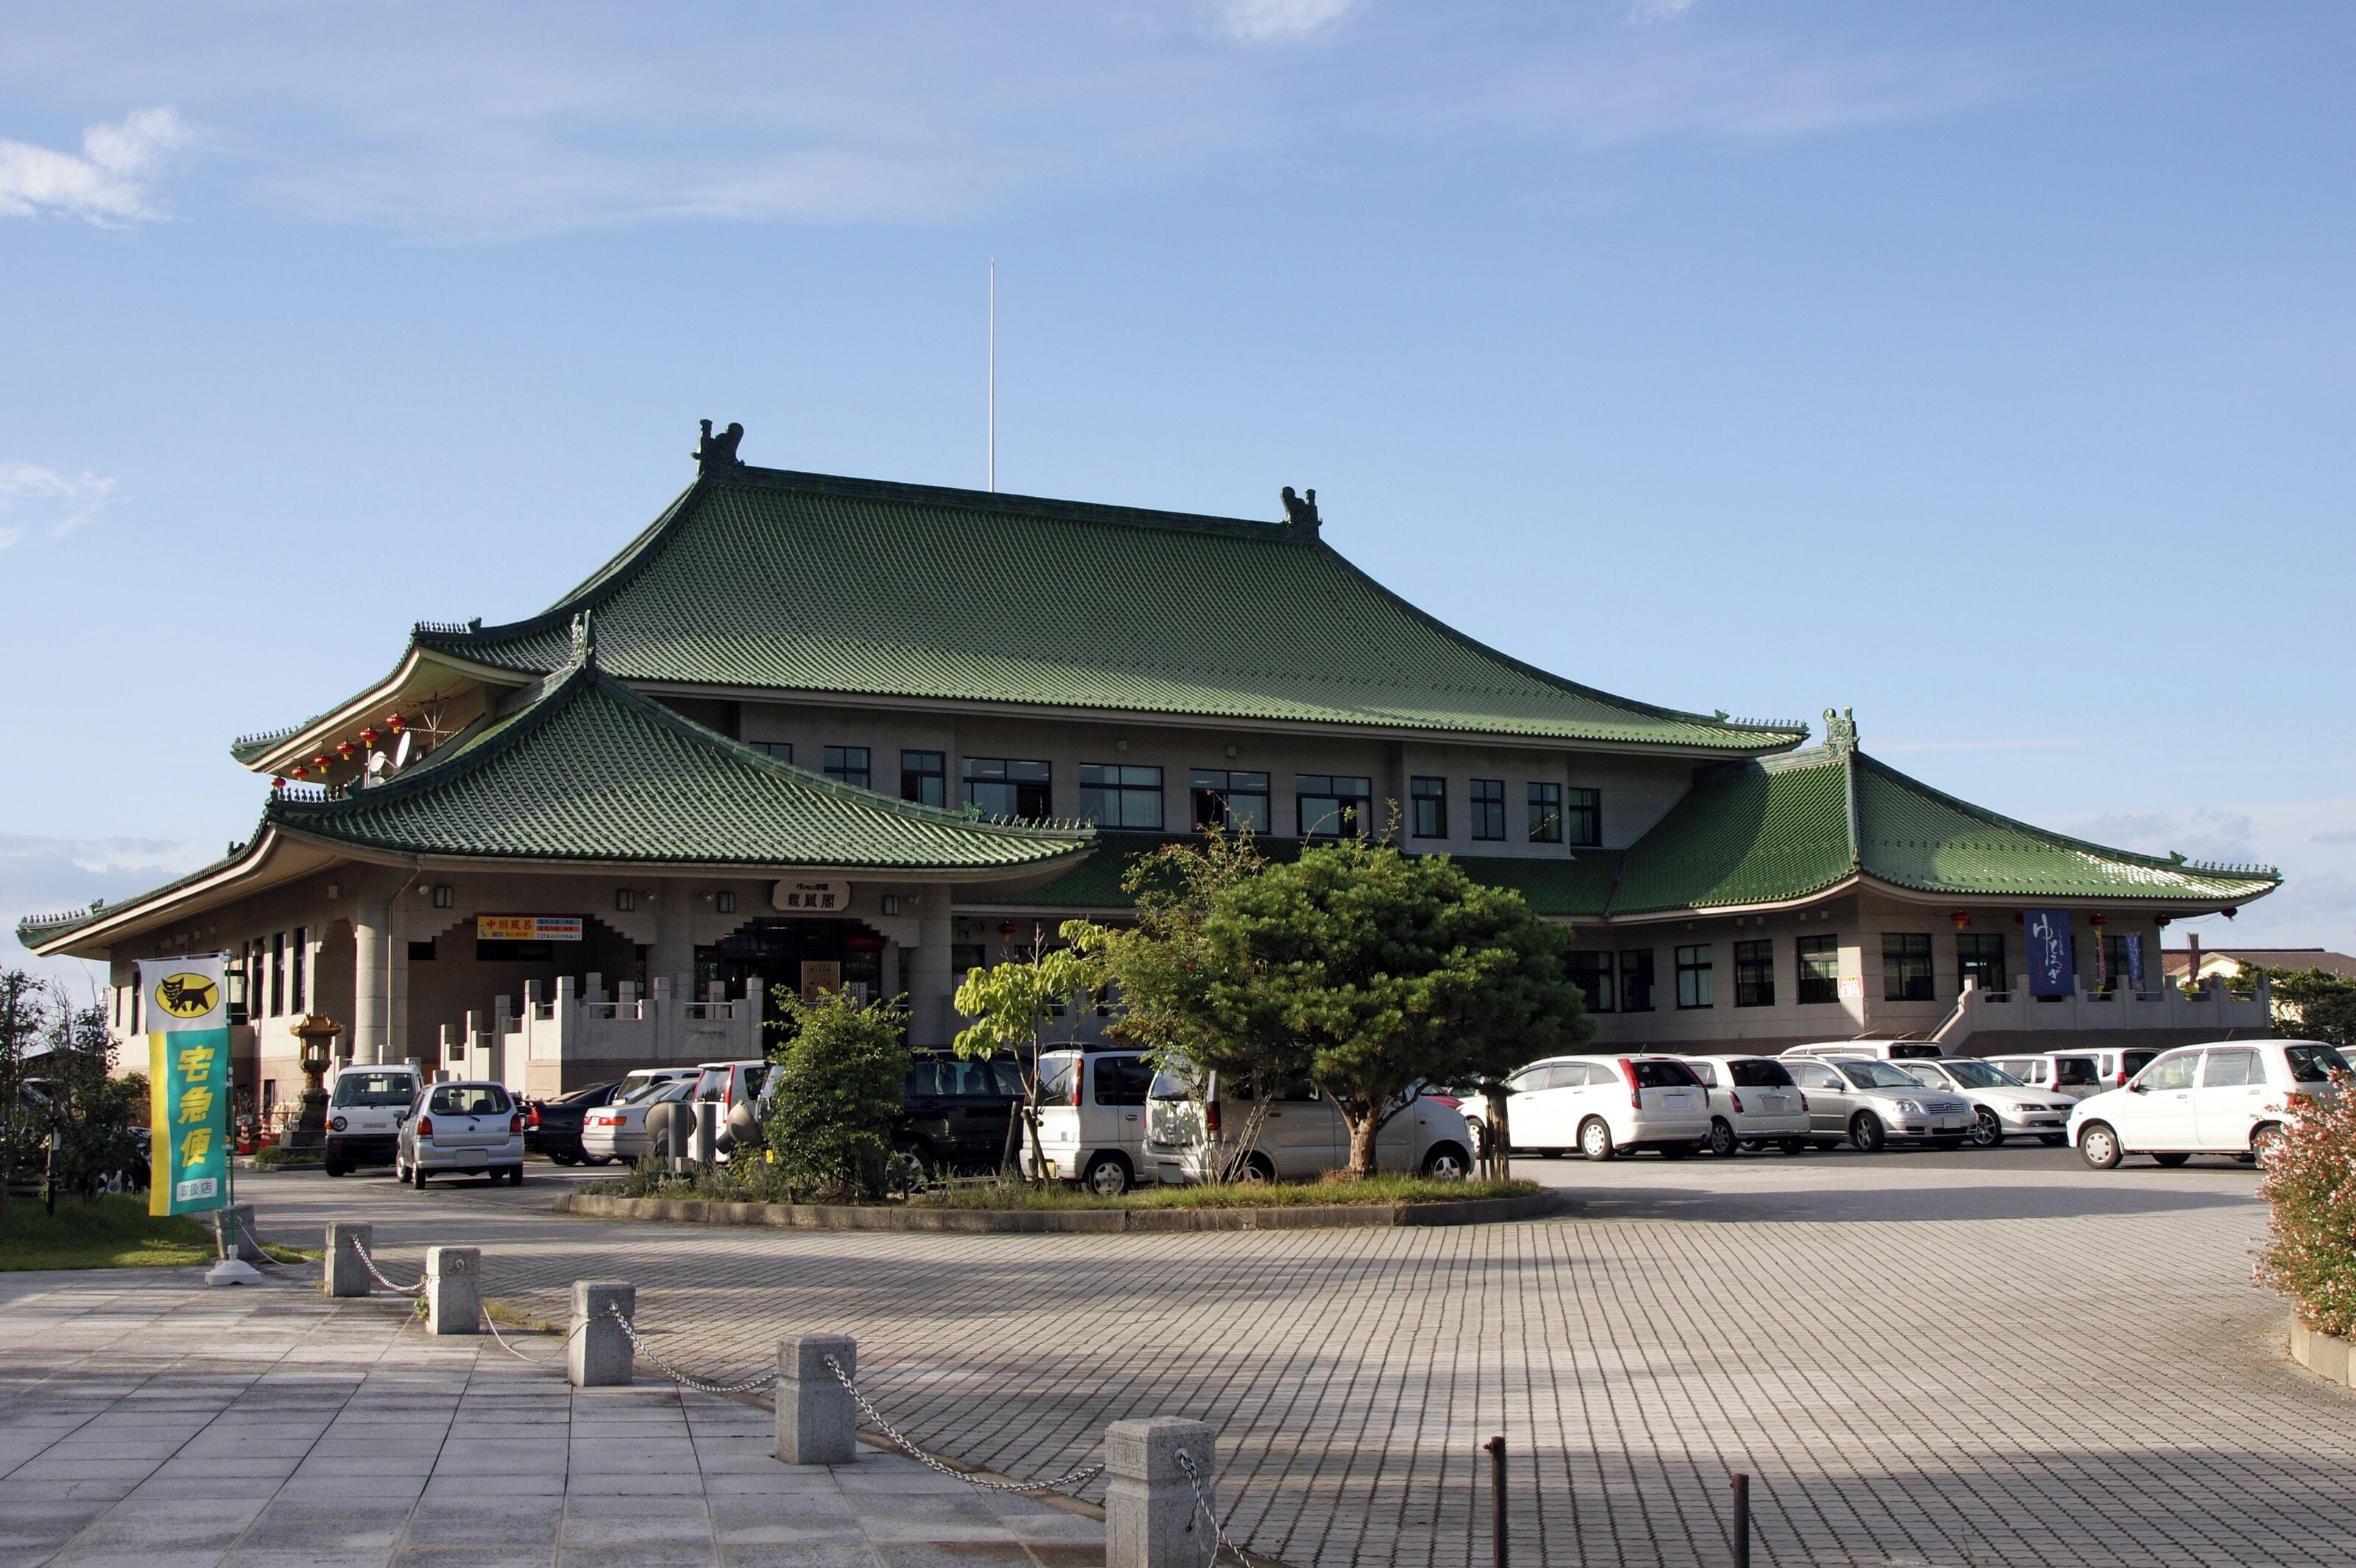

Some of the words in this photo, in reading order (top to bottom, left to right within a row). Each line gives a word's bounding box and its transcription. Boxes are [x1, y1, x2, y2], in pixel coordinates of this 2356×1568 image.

[487, 919, 532, 930] 中国風呂
[2033, 913, 2062, 984] ゆとろぎ
[177, 1045, 215, 1167] 宅急便
[180, 1182, 213, 1197] 取扱店
